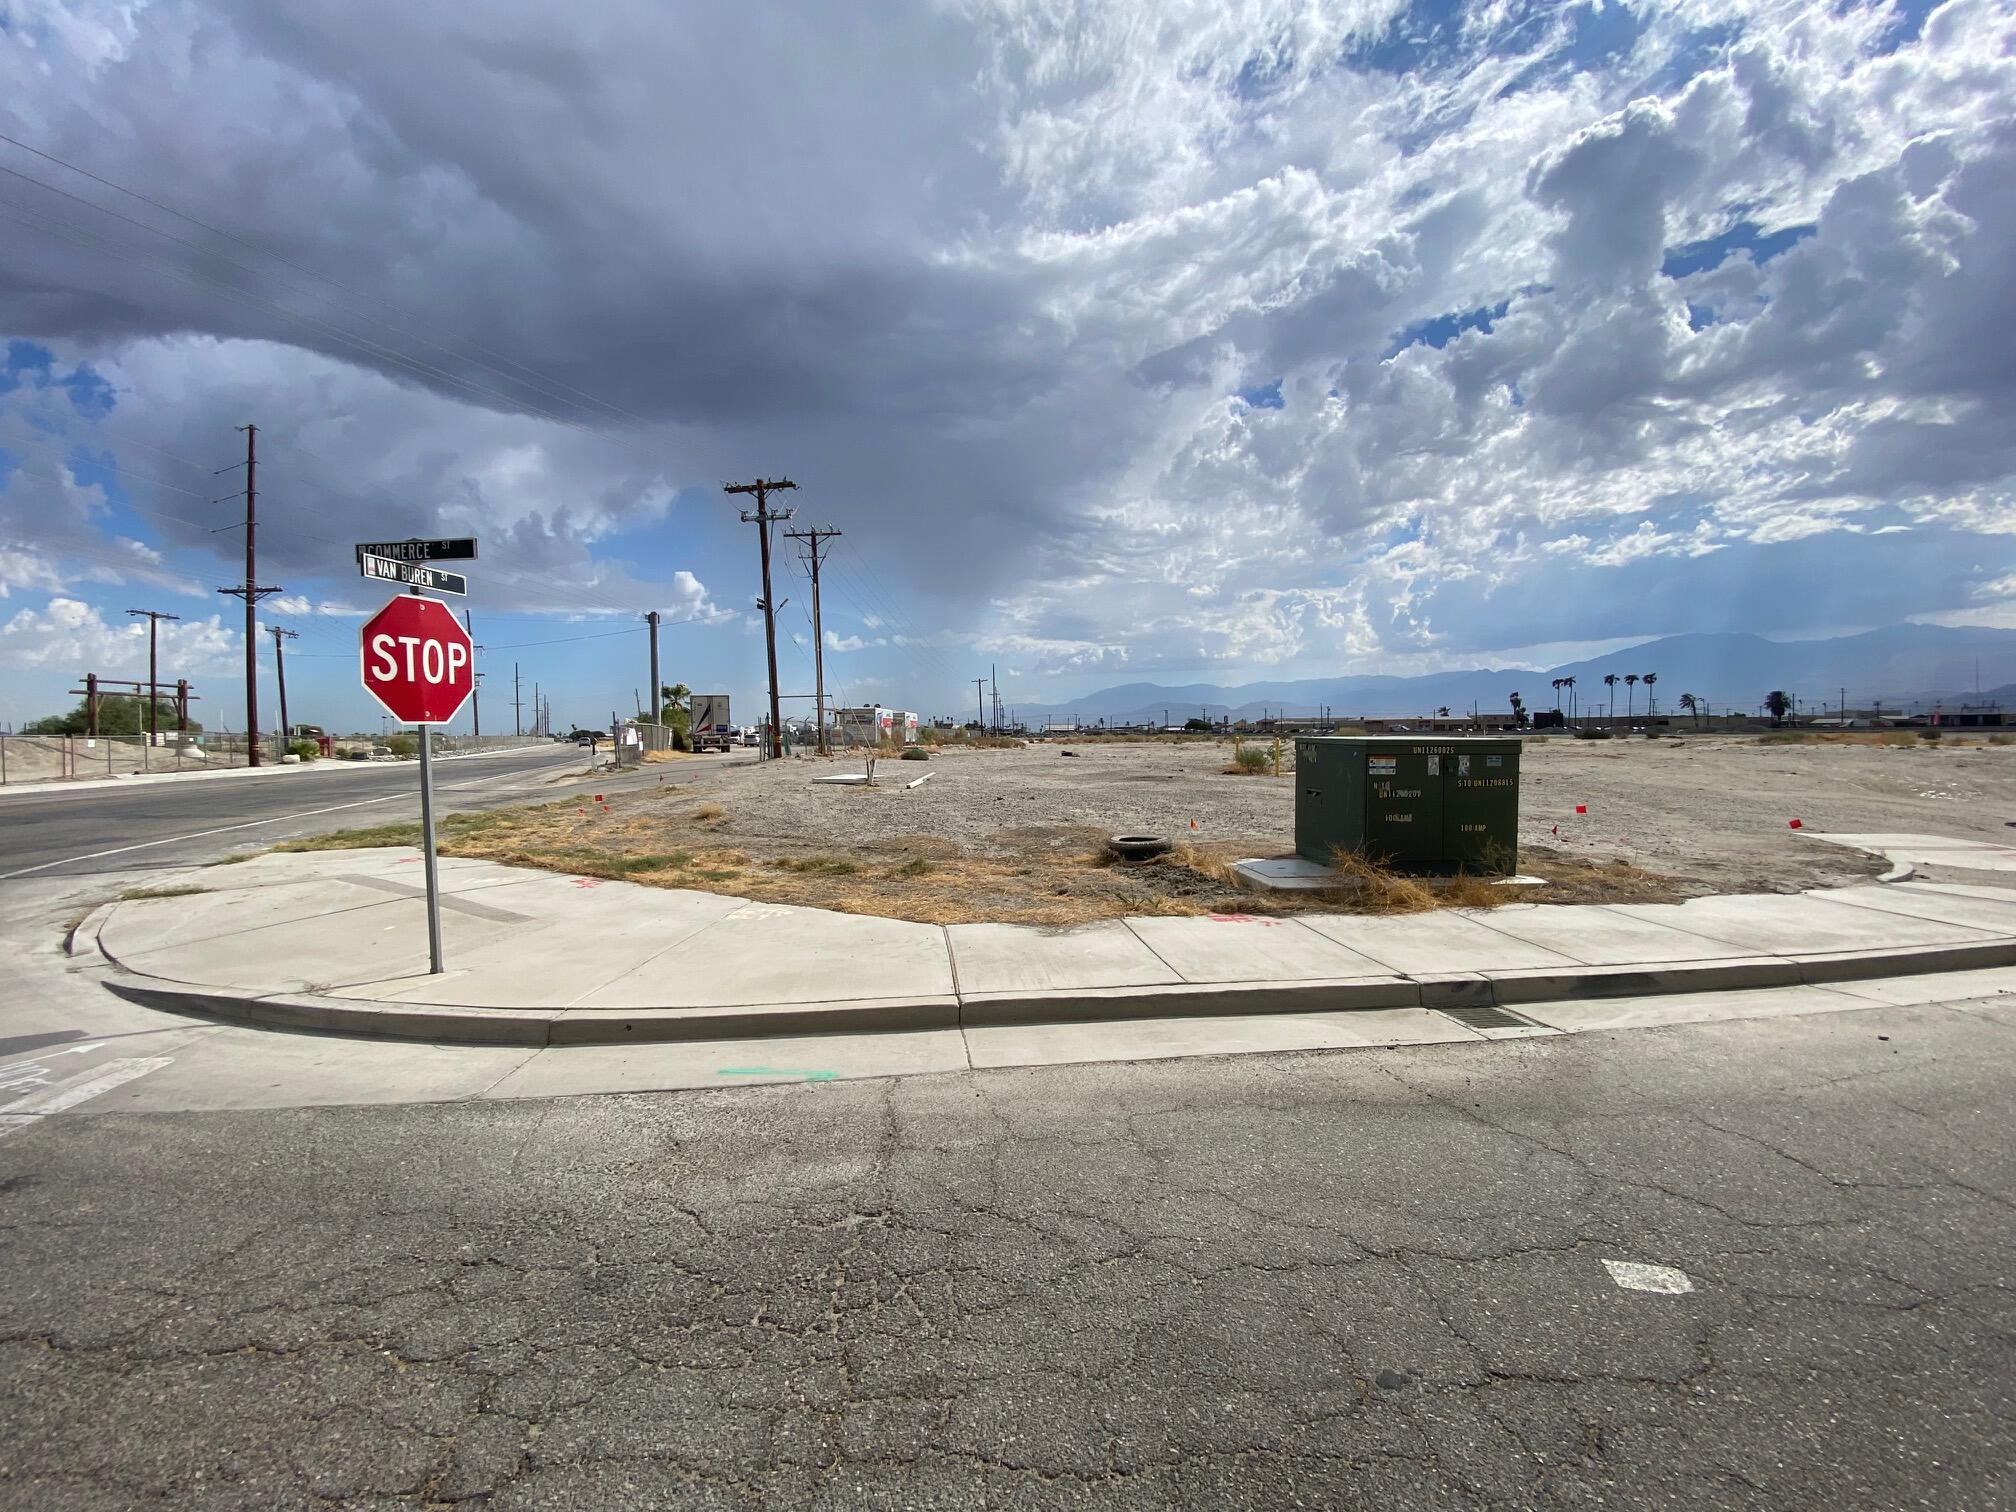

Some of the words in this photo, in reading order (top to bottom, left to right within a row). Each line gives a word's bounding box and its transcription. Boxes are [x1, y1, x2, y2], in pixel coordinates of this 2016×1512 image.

[367, 543, 431, 560] COMMERCE
[442, 541, 450, 550] ST
[377, 559, 397, 579] VAN
[401, 565, 433, 587] BUREN
[441, 573, 448, 582] ST
[371, 633, 467, 685] STOP
[1461, 824, 1473, 832] 100
